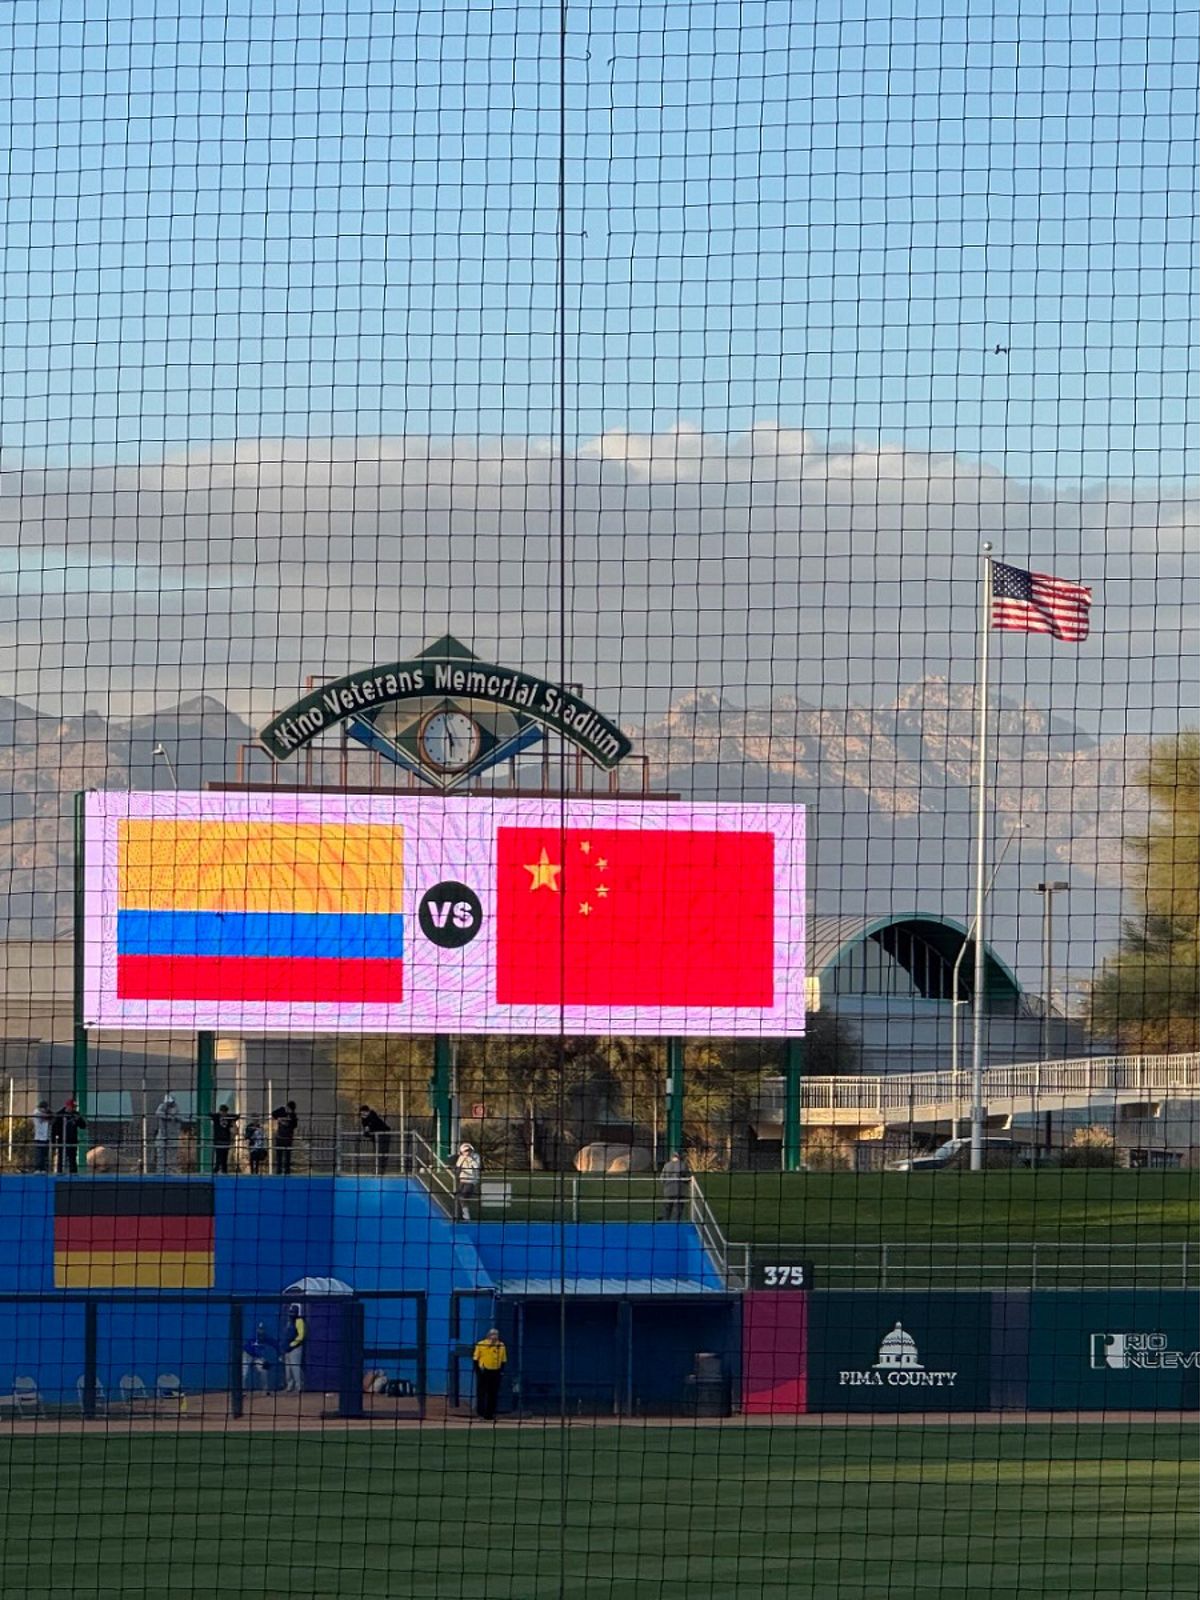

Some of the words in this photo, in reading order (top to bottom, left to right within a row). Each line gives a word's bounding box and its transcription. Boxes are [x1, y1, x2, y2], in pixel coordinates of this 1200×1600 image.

[273, 703, 323, 753] Kino
[323, 666, 425, 716] Veterans
[434, 663, 538, 706] Memorial
[540, 687, 622, 760] Stadium
[427, 901, 474, 929] VS
[763, 1265, 804, 1286] 375
[1123, 1333, 1168, 1350] RIO
[838, 1371, 884, 1387] PIMA
[886, 1371, 958, 1388] COUNTY
